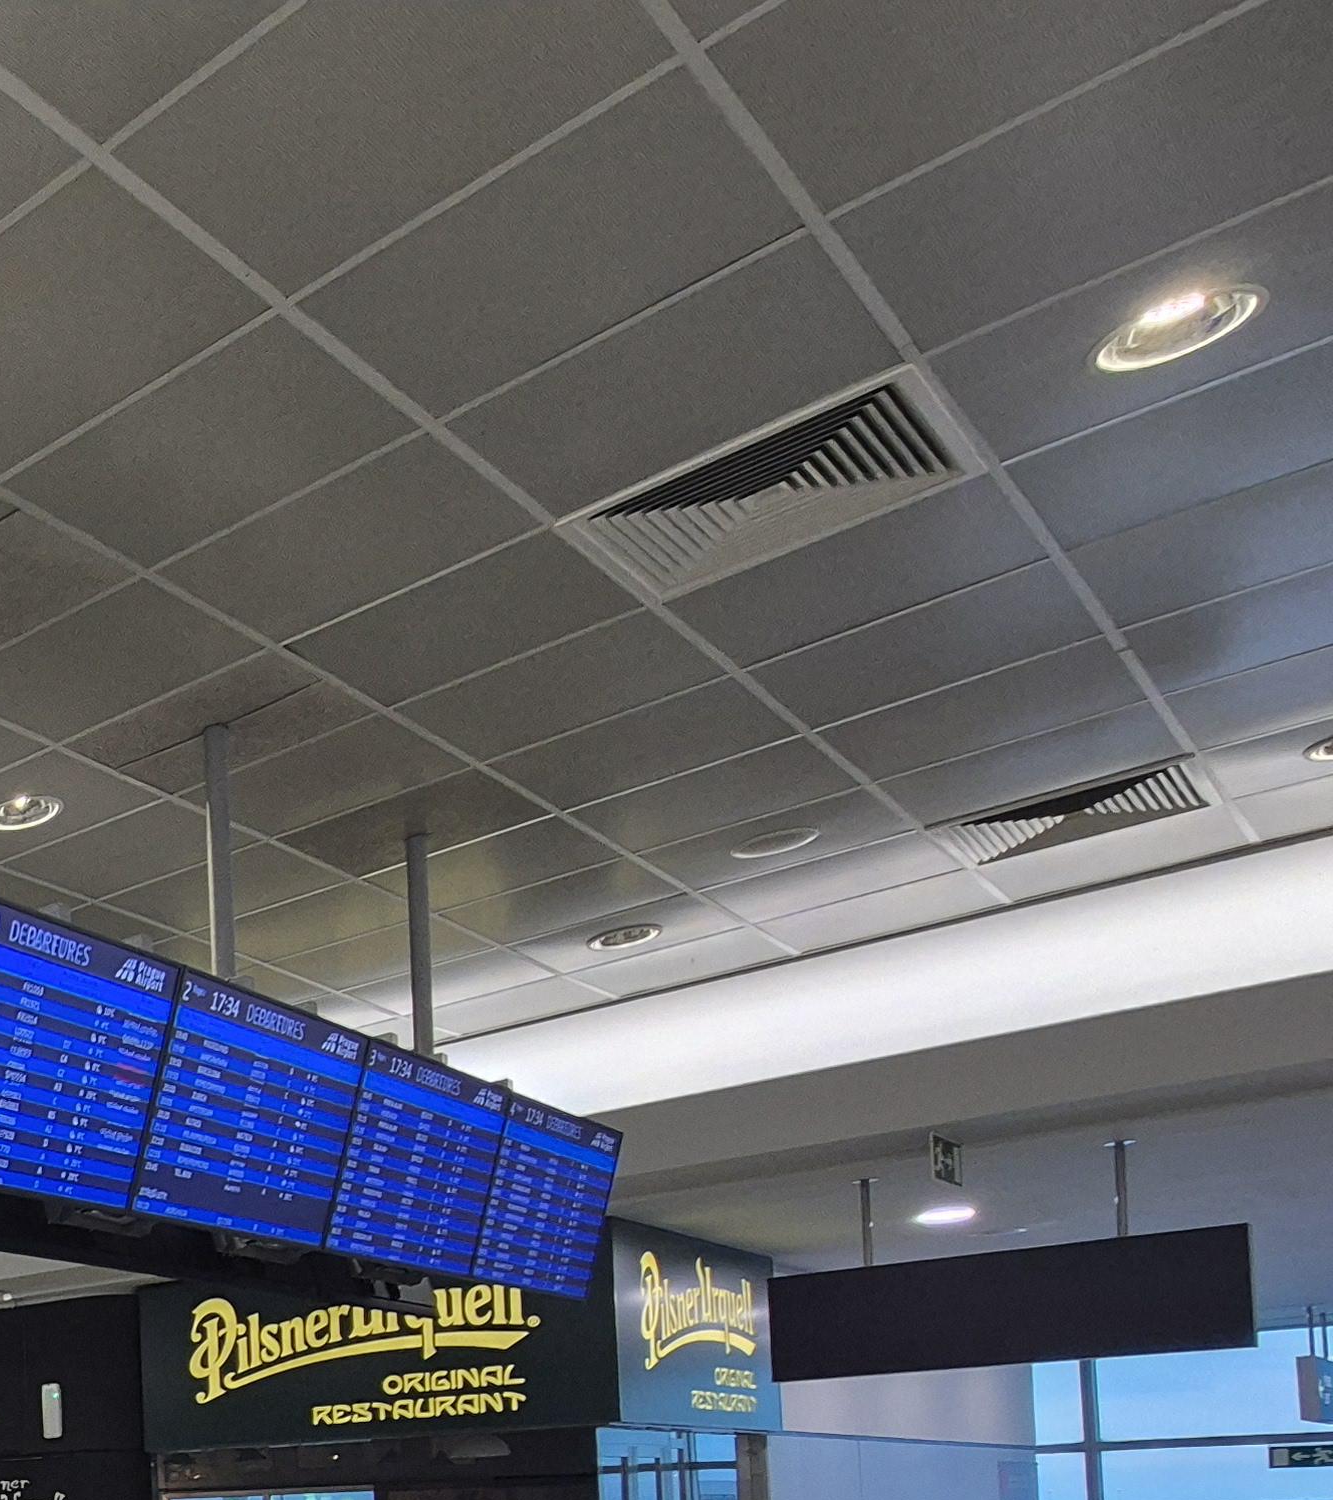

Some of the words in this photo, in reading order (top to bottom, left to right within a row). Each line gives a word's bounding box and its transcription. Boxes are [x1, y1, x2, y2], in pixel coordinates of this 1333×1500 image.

[9, 919, 92, 967] DEPARTURES
[182, 981, 192, 1001] 2
[210, 991, 241, 1018] 17:34
[245, 1004, 307, 1041] DEPARTURES
[368, 1049, 377, 1066] 3
[388, 1056, 412, 1079] 17:34
[524, 1107, 545, 1127] 17:34
[640, 1250, 703, 1371] Pilsner
[694, 1256, 756, 1355] Urquell
[189, 1297, 349, 1405] Pilsner
[381, 1364, 527, 1395] ORIGINAL
[311, 1391, 527, 1427] RESTAURANT
